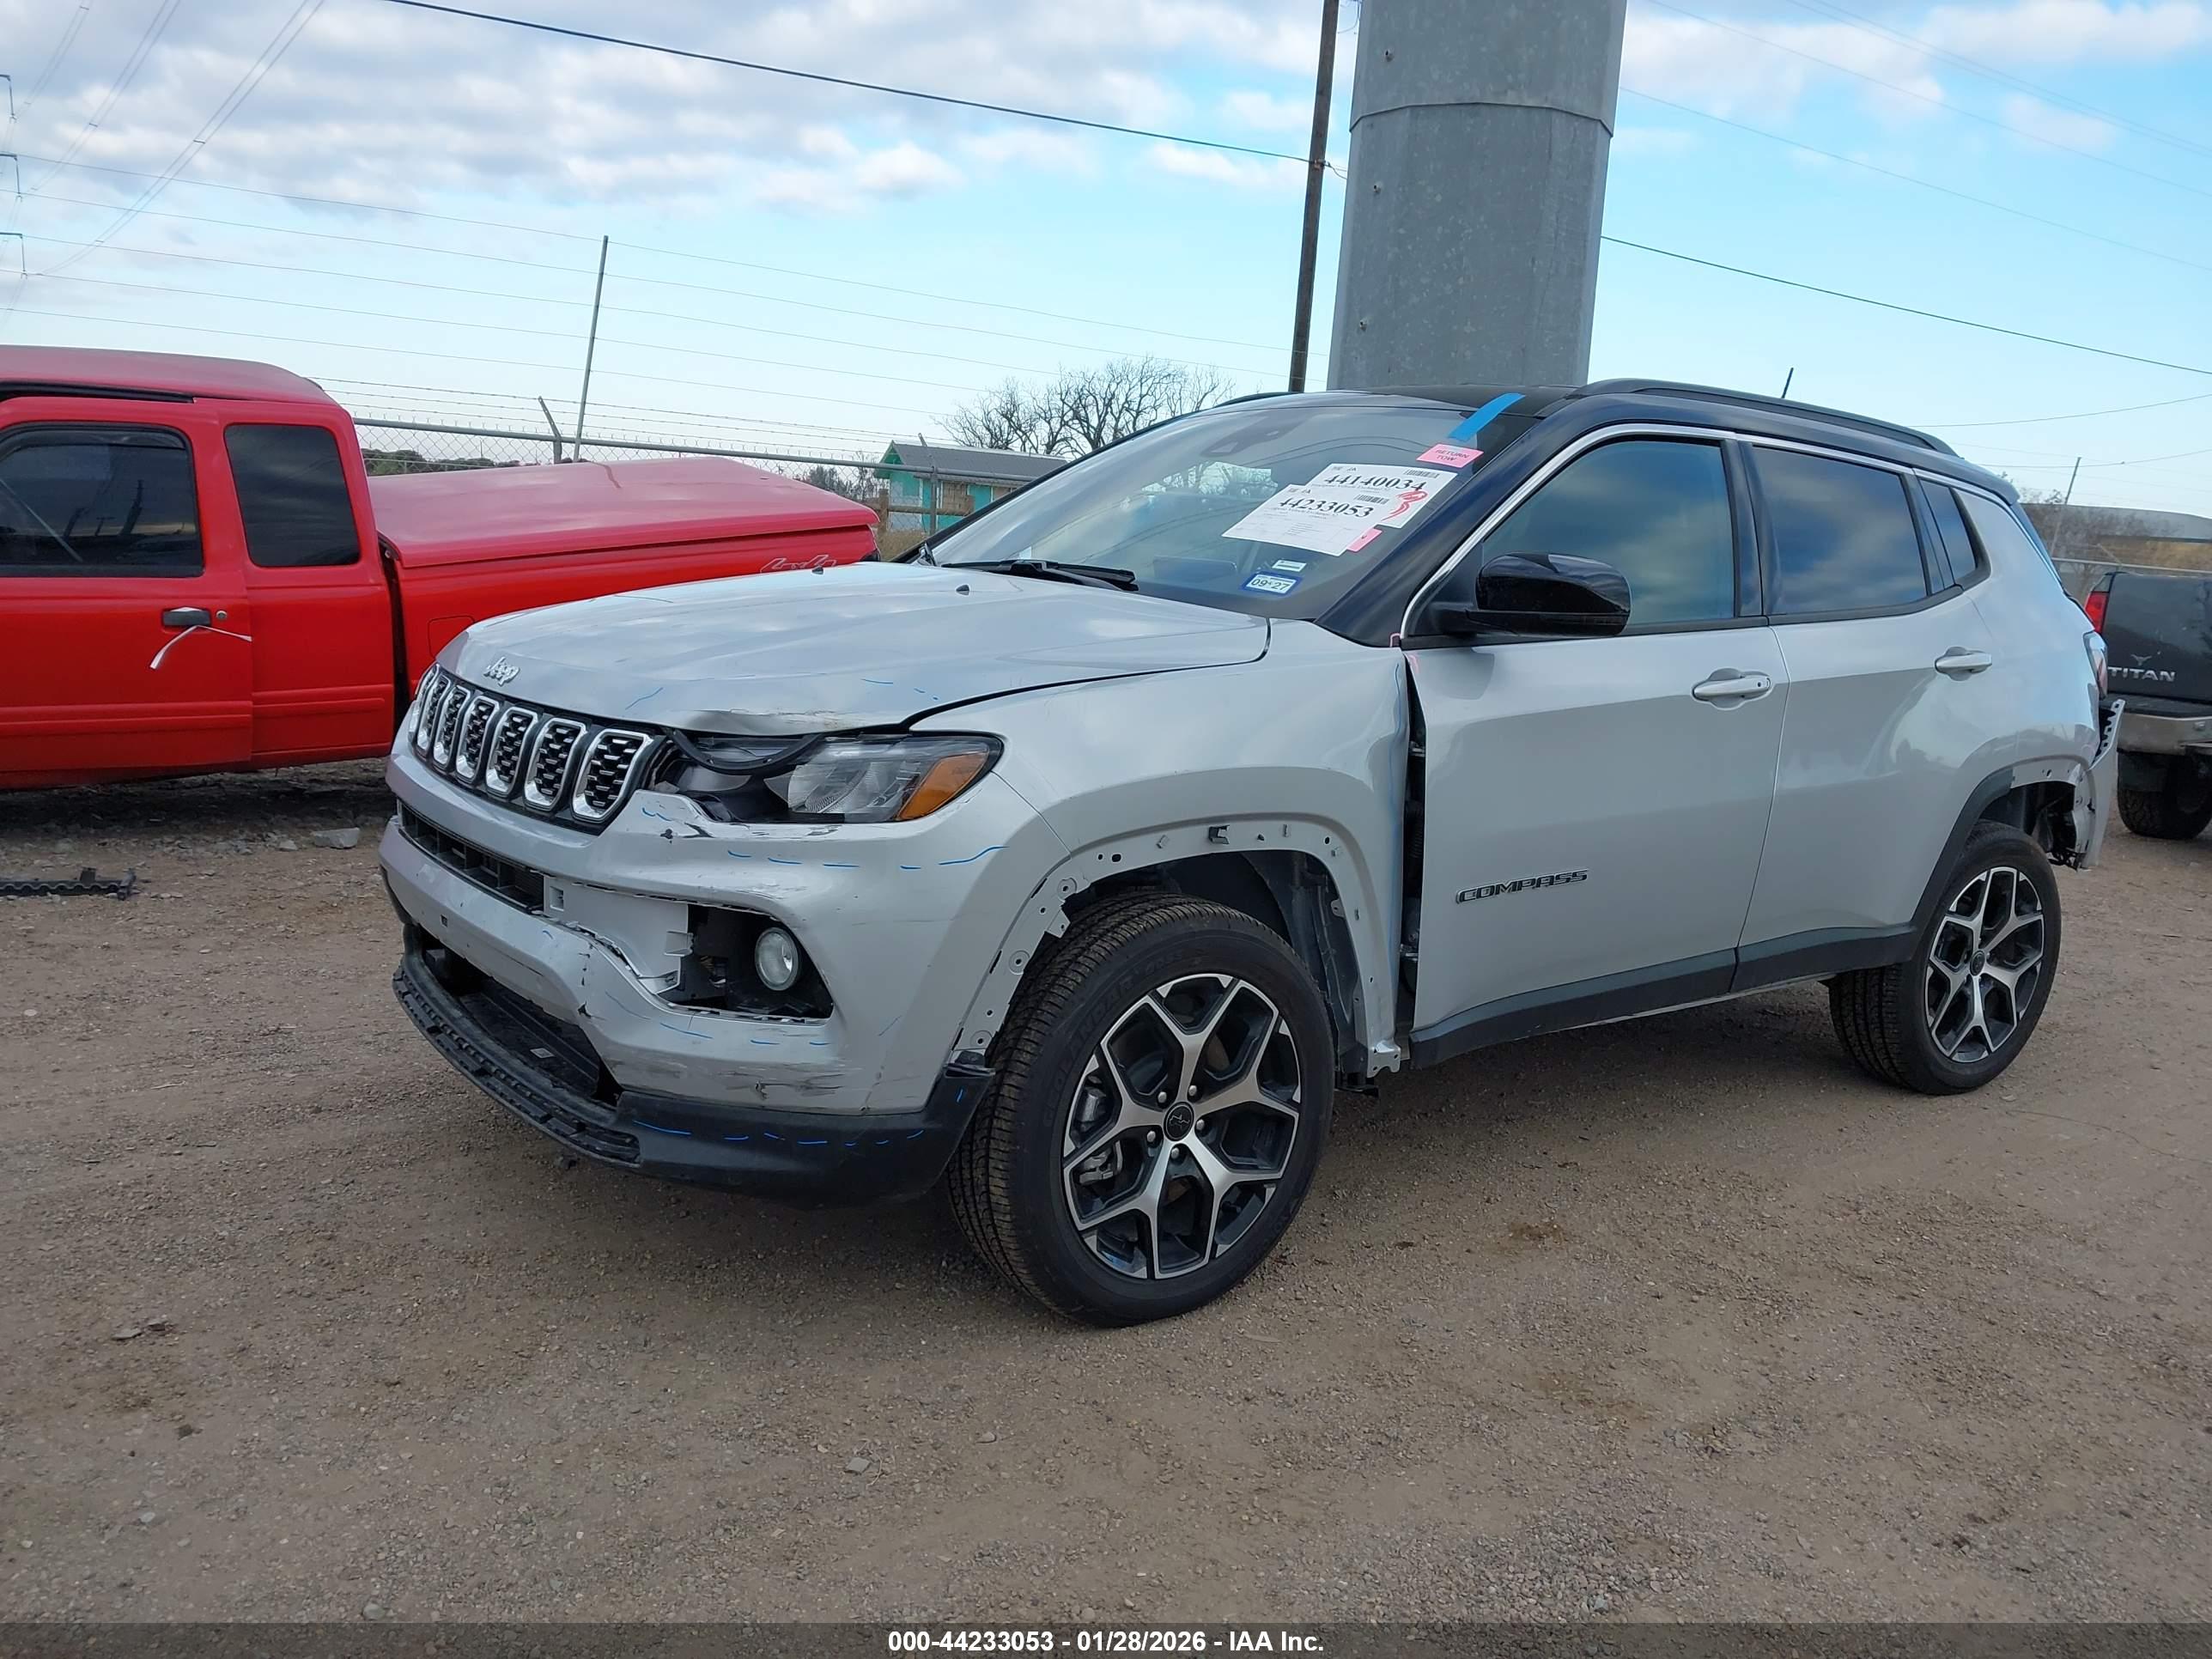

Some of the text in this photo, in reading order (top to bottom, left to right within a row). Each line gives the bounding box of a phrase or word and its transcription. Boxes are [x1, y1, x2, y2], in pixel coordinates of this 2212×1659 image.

[1435, 449, 1470, 459] RETURN
[1325, 474, 1426, 491] 44140034
[1279, 496, 1374, 518] 44233053
[1250, 578, 1291, 591] 09 27
[483, 656, 520, 686] Jeep
[2108, 666, 2176, 682] TITAN
[1455, 868, 1589, 904] COMPASS
